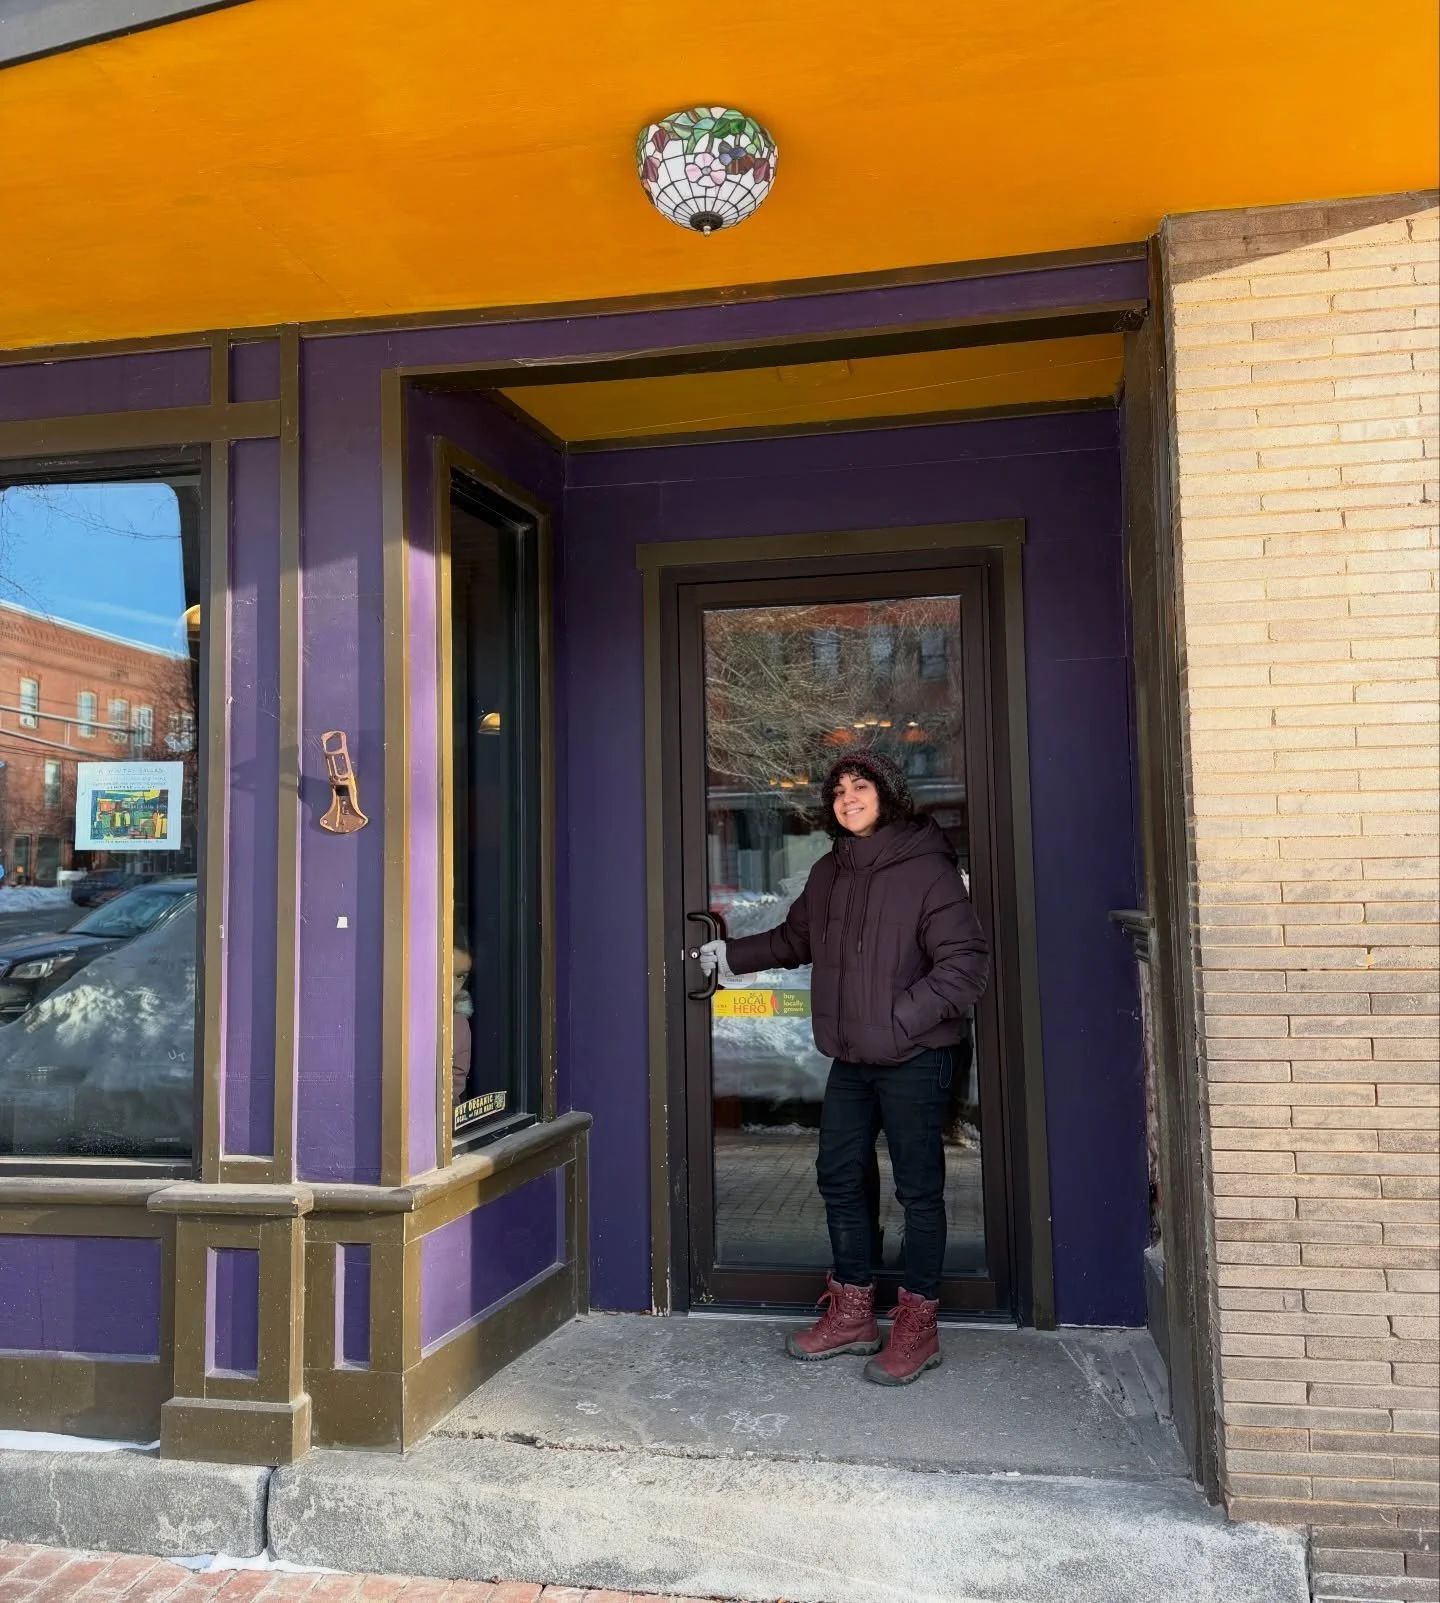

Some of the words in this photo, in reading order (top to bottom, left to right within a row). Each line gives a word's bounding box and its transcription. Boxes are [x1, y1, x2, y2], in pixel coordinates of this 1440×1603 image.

[733, 996, 766, 1005] LOCAL
[783, 992, 795, 1001] buy
[783, 1000, 804, 1008] locally
[733, 1004, 767, 1014] HERO
[468, 1094, 493, 1110] ORGANIC
